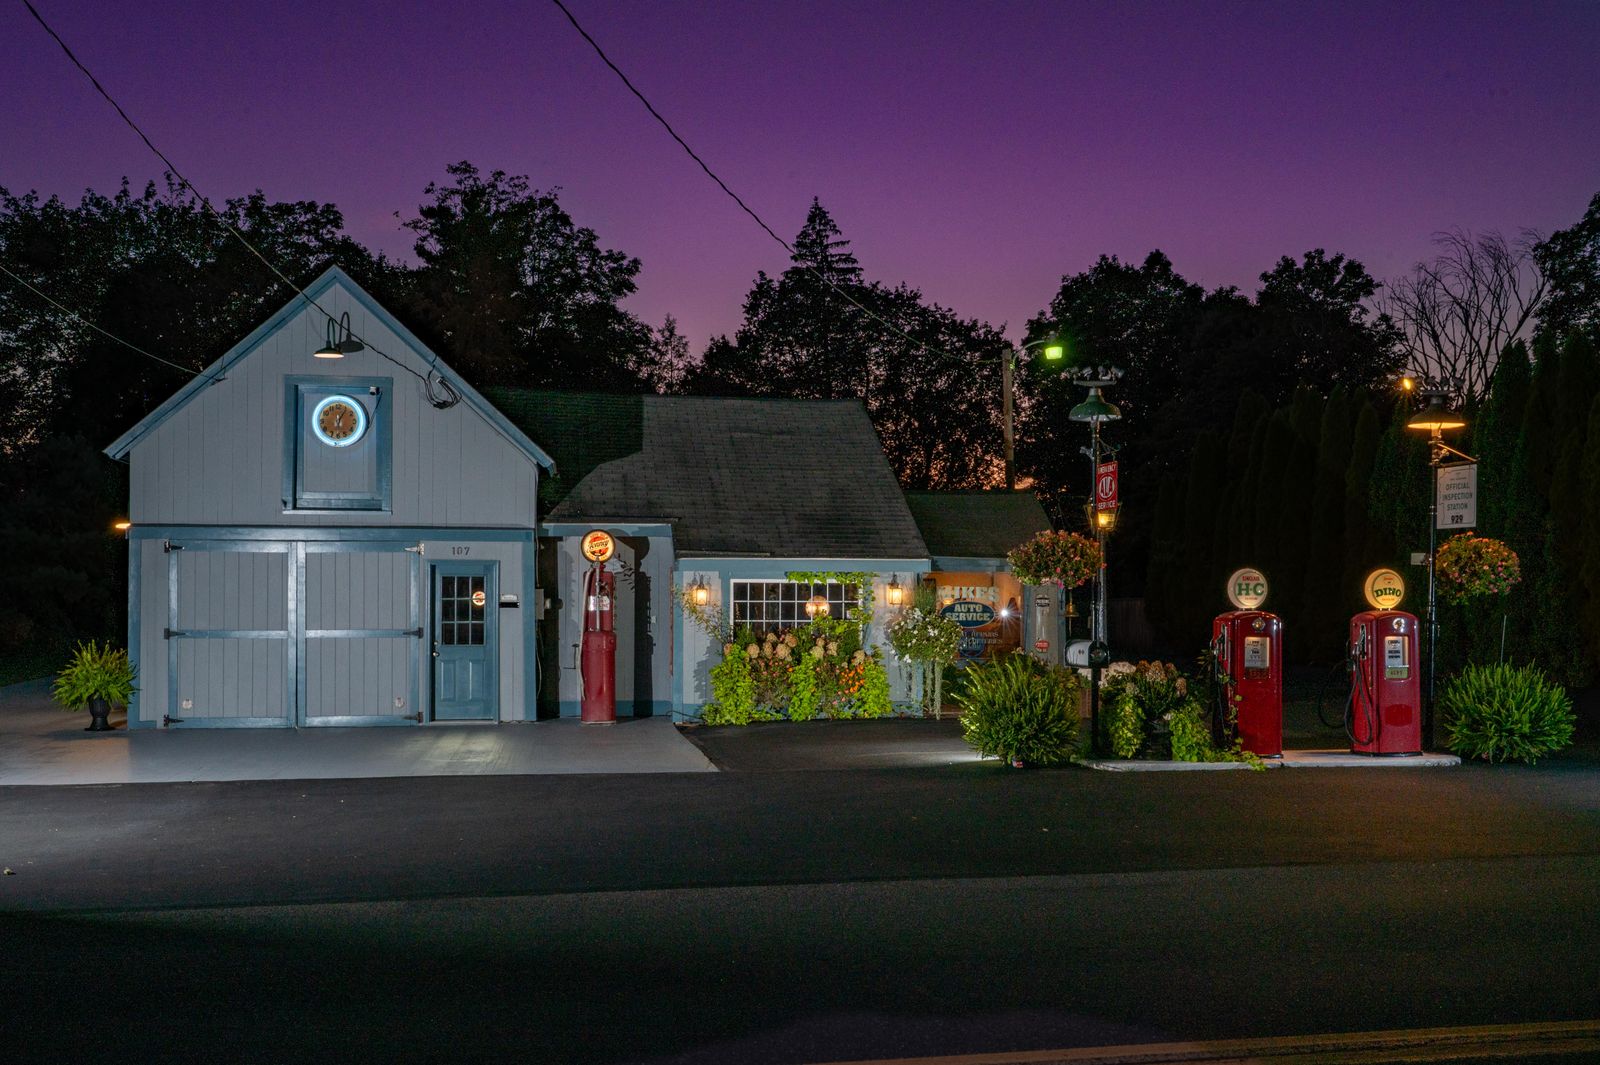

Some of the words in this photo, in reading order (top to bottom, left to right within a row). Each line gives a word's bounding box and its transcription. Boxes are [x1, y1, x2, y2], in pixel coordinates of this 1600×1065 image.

[1445, 482, 1470, 491] OFFICIAL
[1441, 492, 1473, 501] INSPECTION
[1098, 500, 1116, 510] SERVICE
[1446, 503, 1469, 511] STATION
[1450, 514, 1464, 525] 929
[452, 546, 471, 556] 107
[1374, 587, 1402, 598] DINO
[954, 604, 983, 613] AUTO
[945, 612, 991, 621] SERVICE
